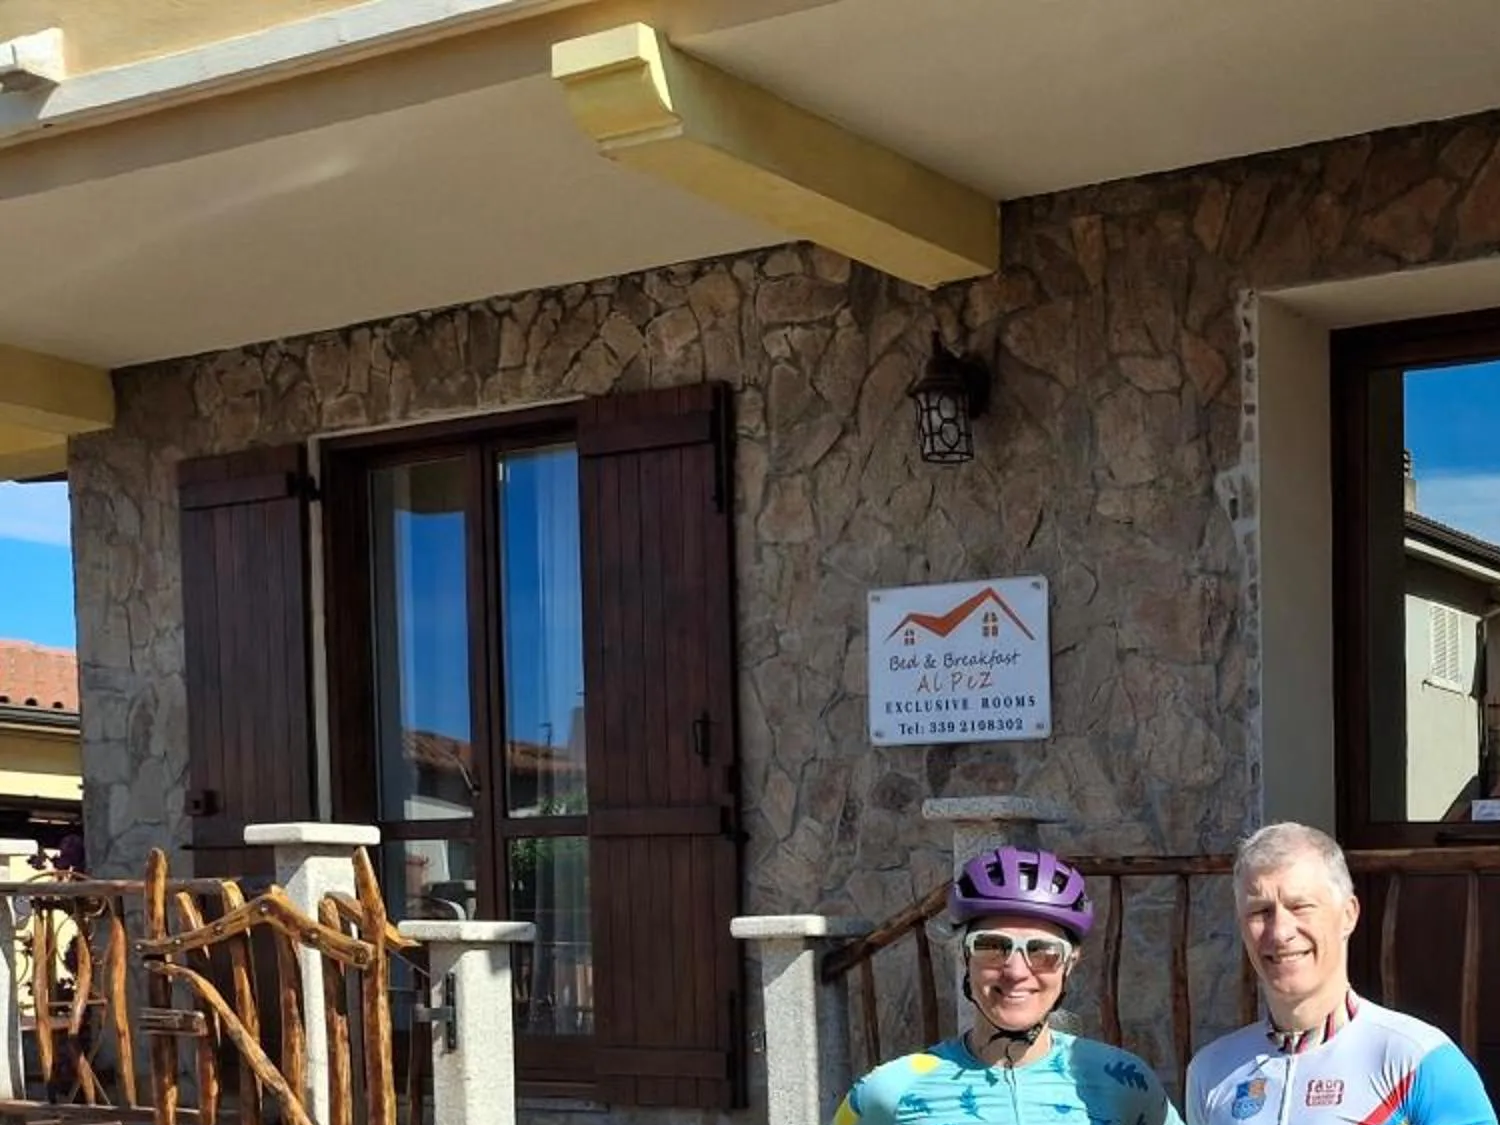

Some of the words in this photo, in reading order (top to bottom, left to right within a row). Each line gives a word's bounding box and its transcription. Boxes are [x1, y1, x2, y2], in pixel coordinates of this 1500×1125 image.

[889, 654, 920, 671] Bed
[923, 652, 937, 669] &
[942, 649, 1021, 671] Breakfast
[885, 698, 970, 714] EXCLUSIVE
[980, 695, 1037, 710] ROOMS
[898, 722, 926, 736] Tel:
[928, 720, 956, 735] 339
[958, 717, 1024, 734] 2108302
